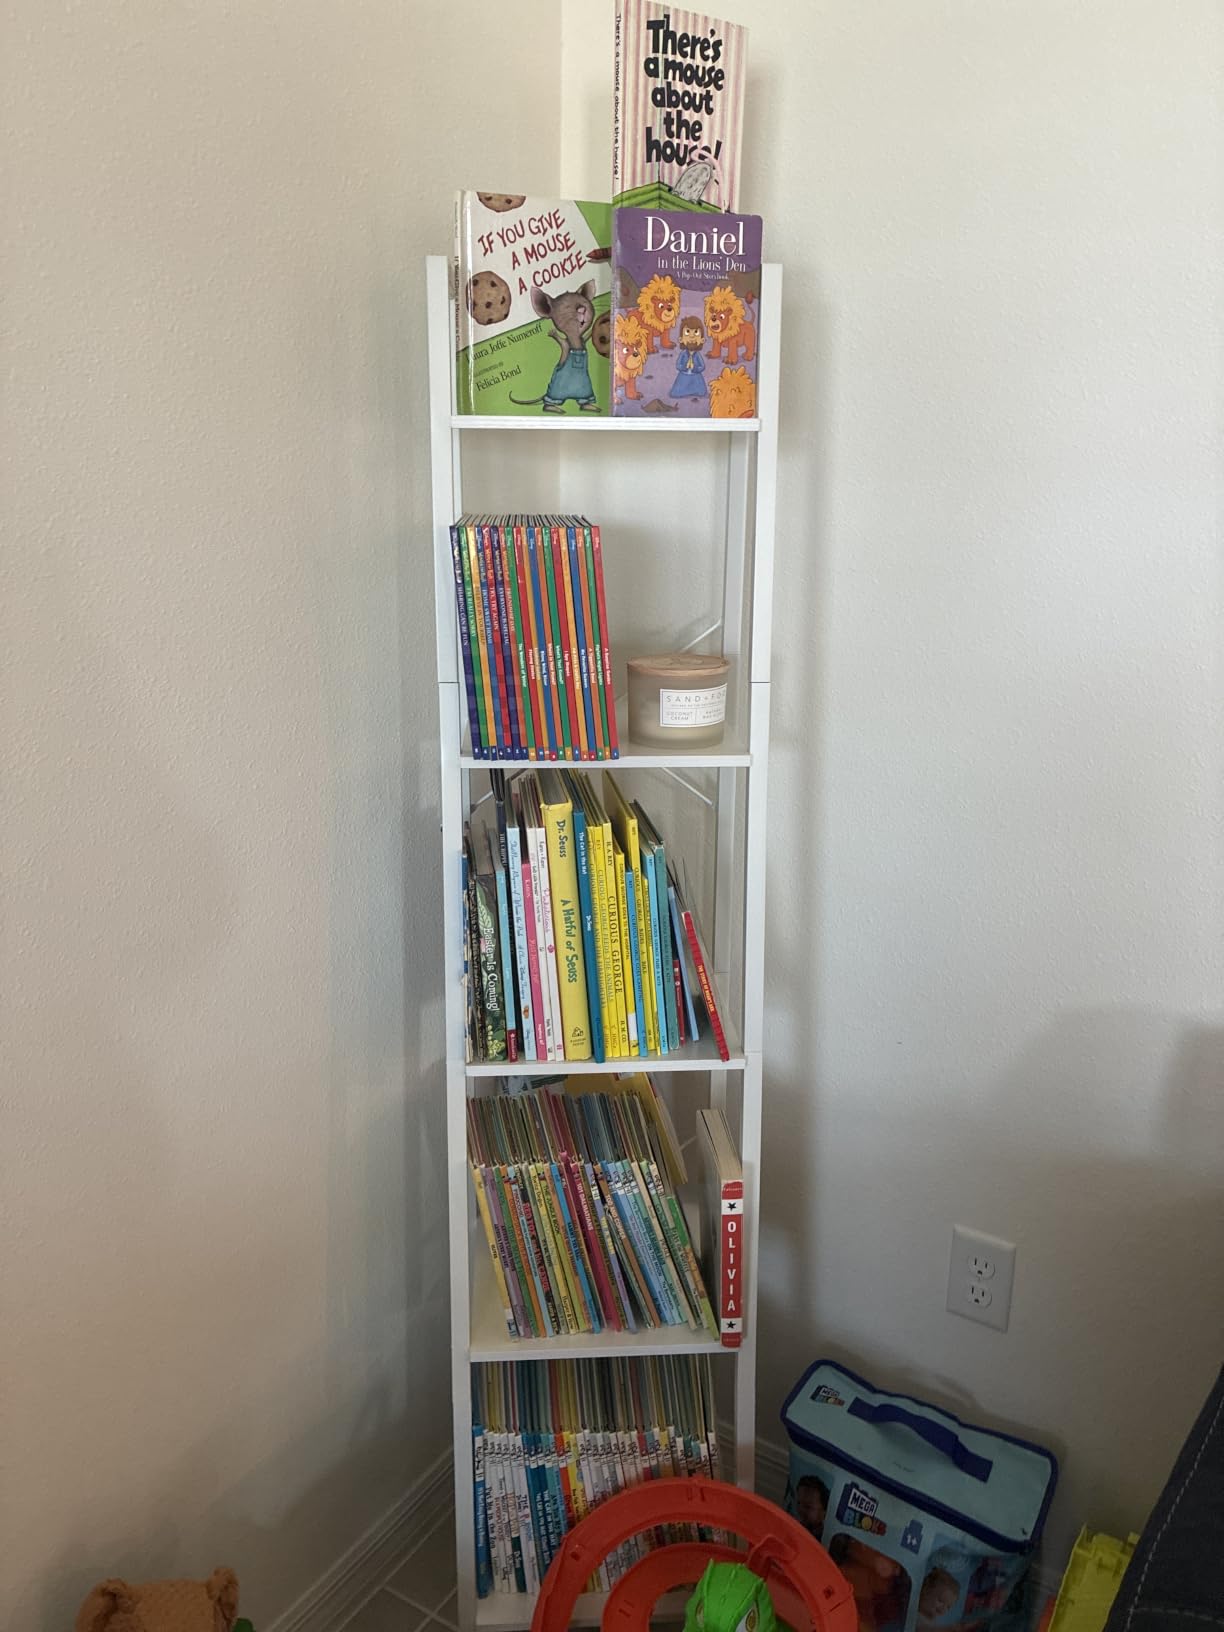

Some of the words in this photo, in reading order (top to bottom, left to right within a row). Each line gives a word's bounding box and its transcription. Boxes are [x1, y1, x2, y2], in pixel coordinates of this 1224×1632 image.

[646, 14, 722, 63] There's
[644, 56, 660, 78] a
[664, 58, 724, 91] mouse
[652, 82, 714, 115] about
[664, 110, 702, 142] the
[478, 232, 494, 256] IF
[497, 220, 525, 248] YOU
[528, 208, 565, 236] GIVE
[643, 216, 746, 256] Daniel
[512, 251, 520, 270] A
[524, 232, 576, 264] MOUSE
[658, 256, 668, 269] in
[672, 255, 689, 270] the
[692, 255, 723, 272] Lions'
[726, 257, 746, 273] Den
[518, 277, 528, 296] A
[532, 250, 587, 288] COOKIE
[489, 340, 508, 354] Joffe
[507, 323, 544, 346] Numeroff
[476, 375, 500, 392] Felicia
[500, 364, 522, 381] Bond
[556, 820, 566, 833] Dr.
[559, 835, 568, 858] Seuss
[562, 908, 576, 937] Hatful
[608, 896, 618, 943] CURIOUS
[484, 926, 495, 958] Easter
[566, 941, 575, 952] of
[487, 961, 496, 971] Is
[566, 954, 579, 983] Seuss
[612, 950, 622, 994] GEORGE
[487, 973, 499, 1011] Coming!
[576, 1183, 584, 1192] 101
[522, 1203, 532, 1218] RED
[579, 1194, 594, 1230] DALMATIANS
[608, 1207, 618, 1217] AND
[526, 1220, 536, 1235] FOX
[727, 1221, 736, 1311] OLIVIA
[851, 1492, 875, 1514] MEGA
